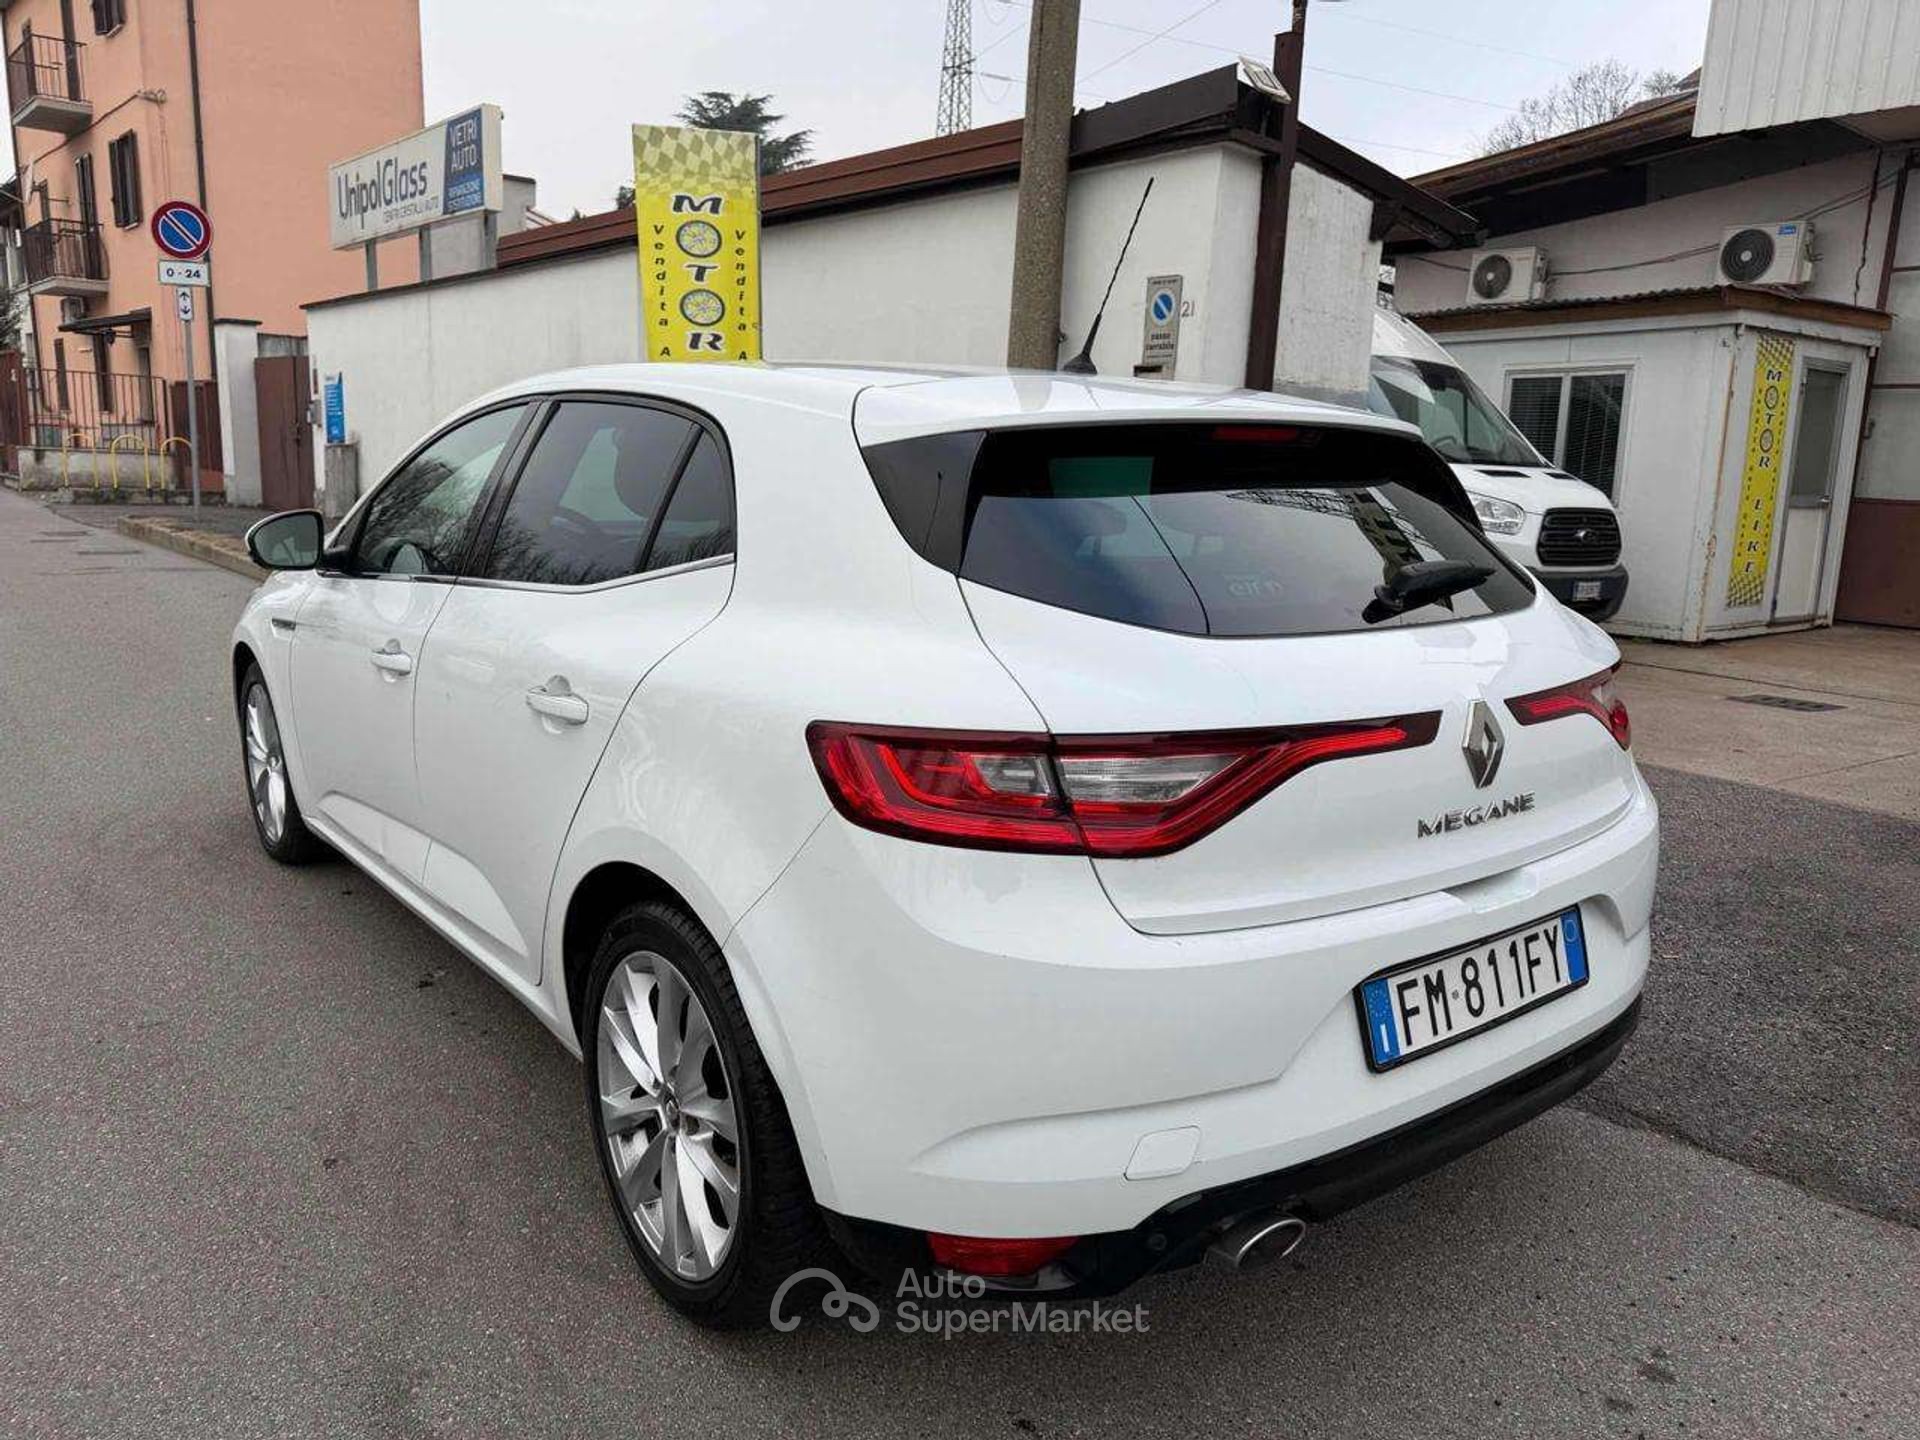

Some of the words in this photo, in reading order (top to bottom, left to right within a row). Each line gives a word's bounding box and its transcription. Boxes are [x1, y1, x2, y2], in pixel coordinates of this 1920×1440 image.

[450, 118, 478, 147] VETRI
[450, 147, 478, 174] AUTO
[337, 157, 428, 229] UnipolGlass
[185, 269, 201, 279] 24
[653, 225, 669, 327] Vendita
[672, 194, 725, 351] MOTOR
[735, 230, 747, 332] Vendita
[1759, 369, 1783, 468] MOTOR
[1417, 792, 1535, 838] MEGANE
